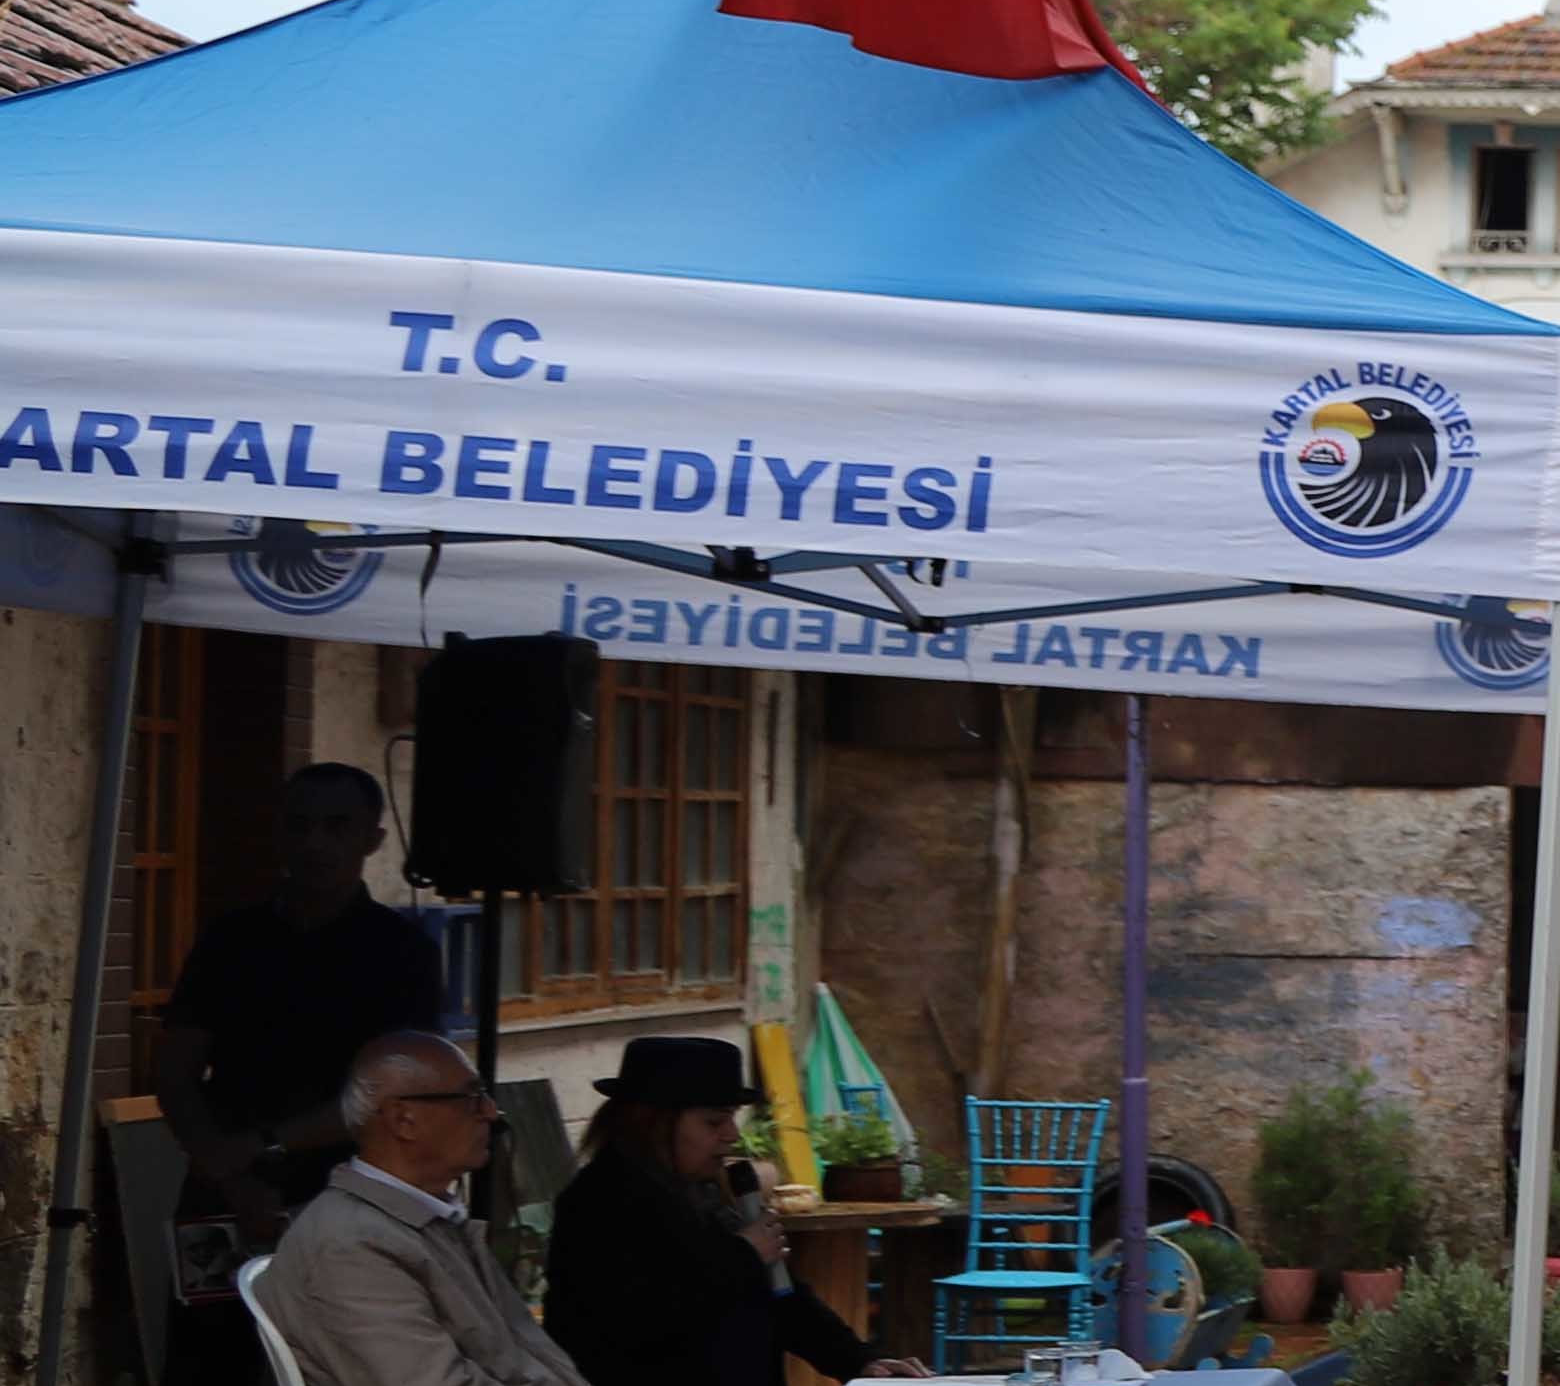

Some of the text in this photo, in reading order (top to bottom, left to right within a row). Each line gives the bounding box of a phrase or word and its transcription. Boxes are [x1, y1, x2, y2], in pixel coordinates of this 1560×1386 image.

[390, 311, 567, 382] T.C.
[1262, 362, 1481, 459] KARTAL BELEDİYESİ
[379, 430, 993, 533] BELEDİYESİ
